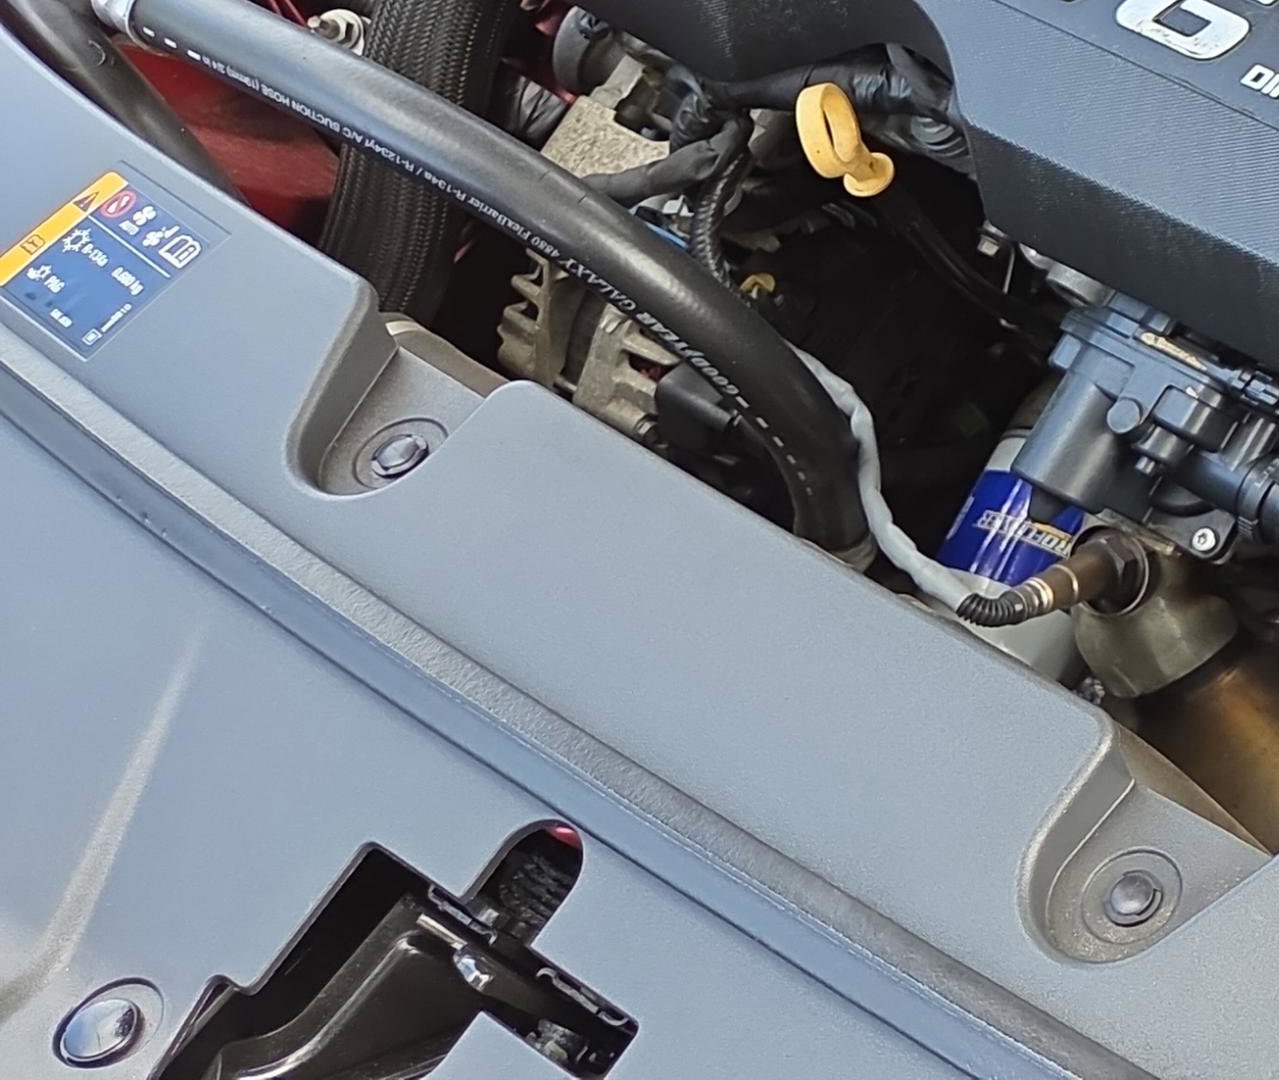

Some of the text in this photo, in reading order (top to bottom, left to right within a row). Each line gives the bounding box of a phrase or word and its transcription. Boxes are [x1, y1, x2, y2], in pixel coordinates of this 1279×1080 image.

[257, 82, 294, 107] HOSE
[289, 98, 341, 132] SUCTION
[340, 125, 364, 143] A/C
[422, 170, 467, 201] R-134a
[466, 195, 532, 240] FlexBarrier
[530, 234, 561, 259] 4880
[559, 253, 637, 313] GALAXY
[635, 310, 741, 396] GOODYEAR
